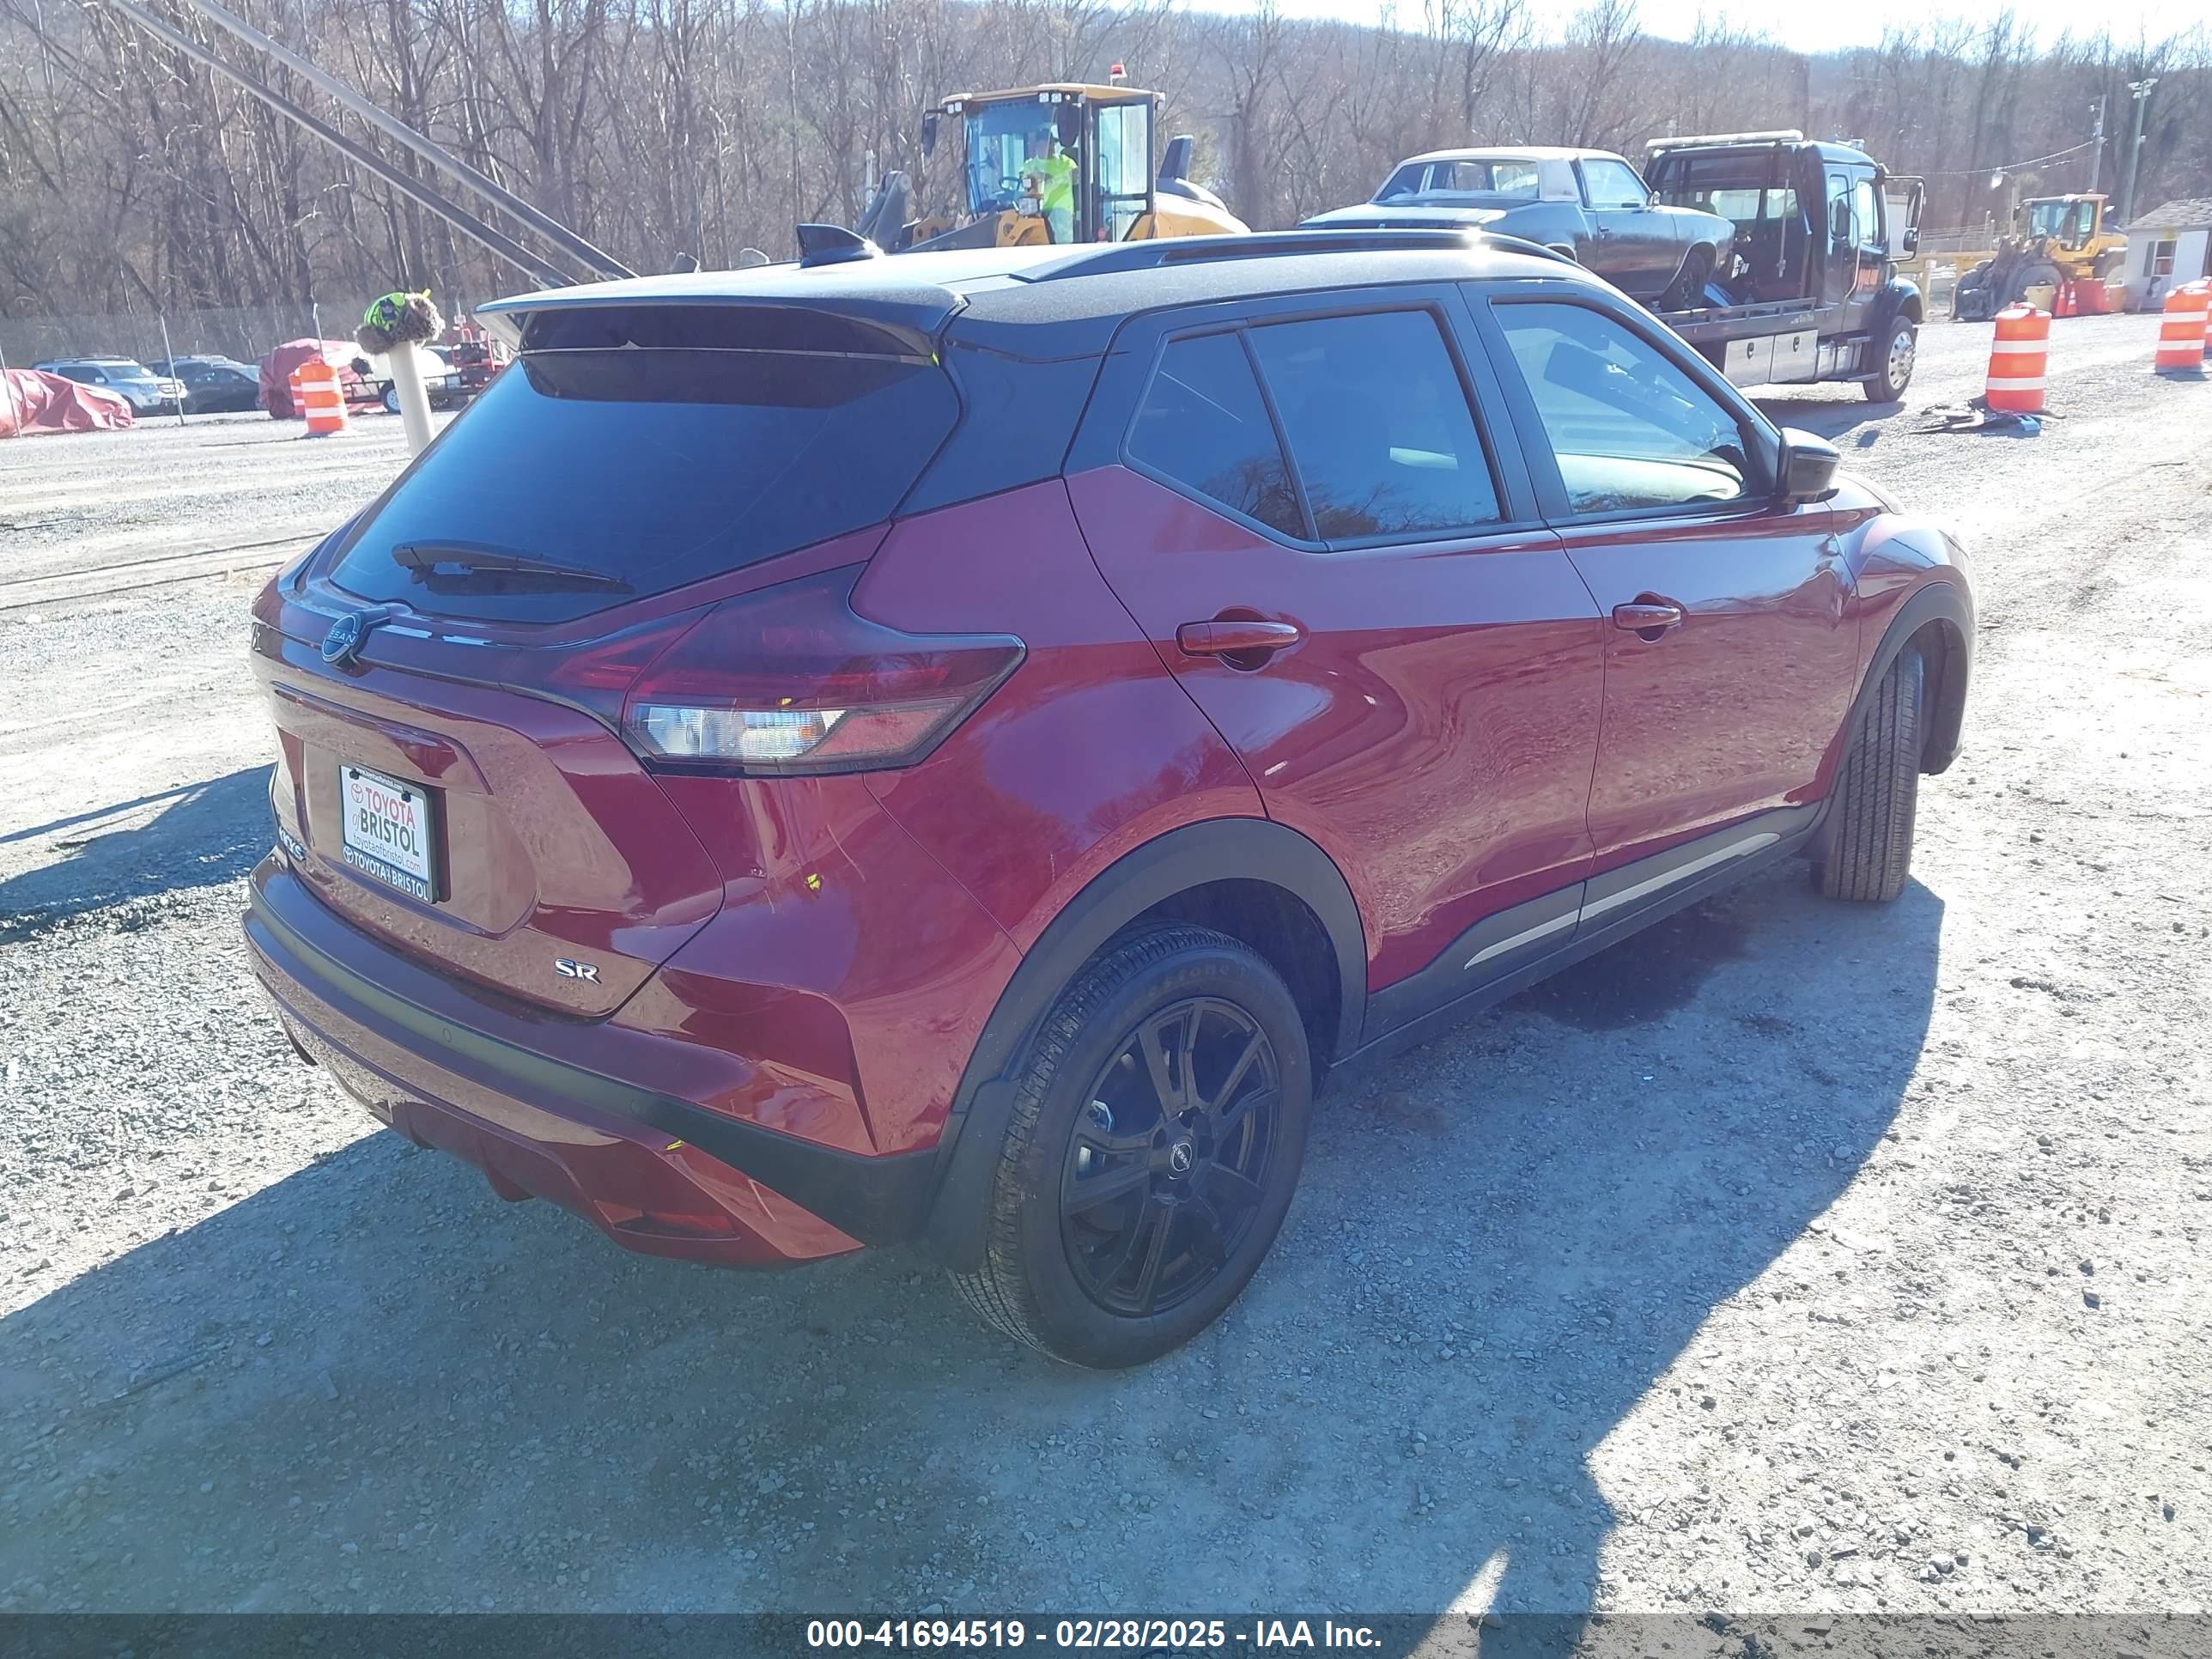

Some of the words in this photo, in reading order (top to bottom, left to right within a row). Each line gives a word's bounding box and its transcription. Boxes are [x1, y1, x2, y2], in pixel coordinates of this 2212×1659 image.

[365, 787, 416, 830] TOYOTA
[352, 812, 361, 831] of
[361, 808, 420, 857] BRISTOL
[354, 833, 422, 873] toyotaofbristol.com
[354, 852, 387, 881] TOYOTA
[392, 871, 428, 902] BRISTOL
[555, 958, 602, 985] SR
